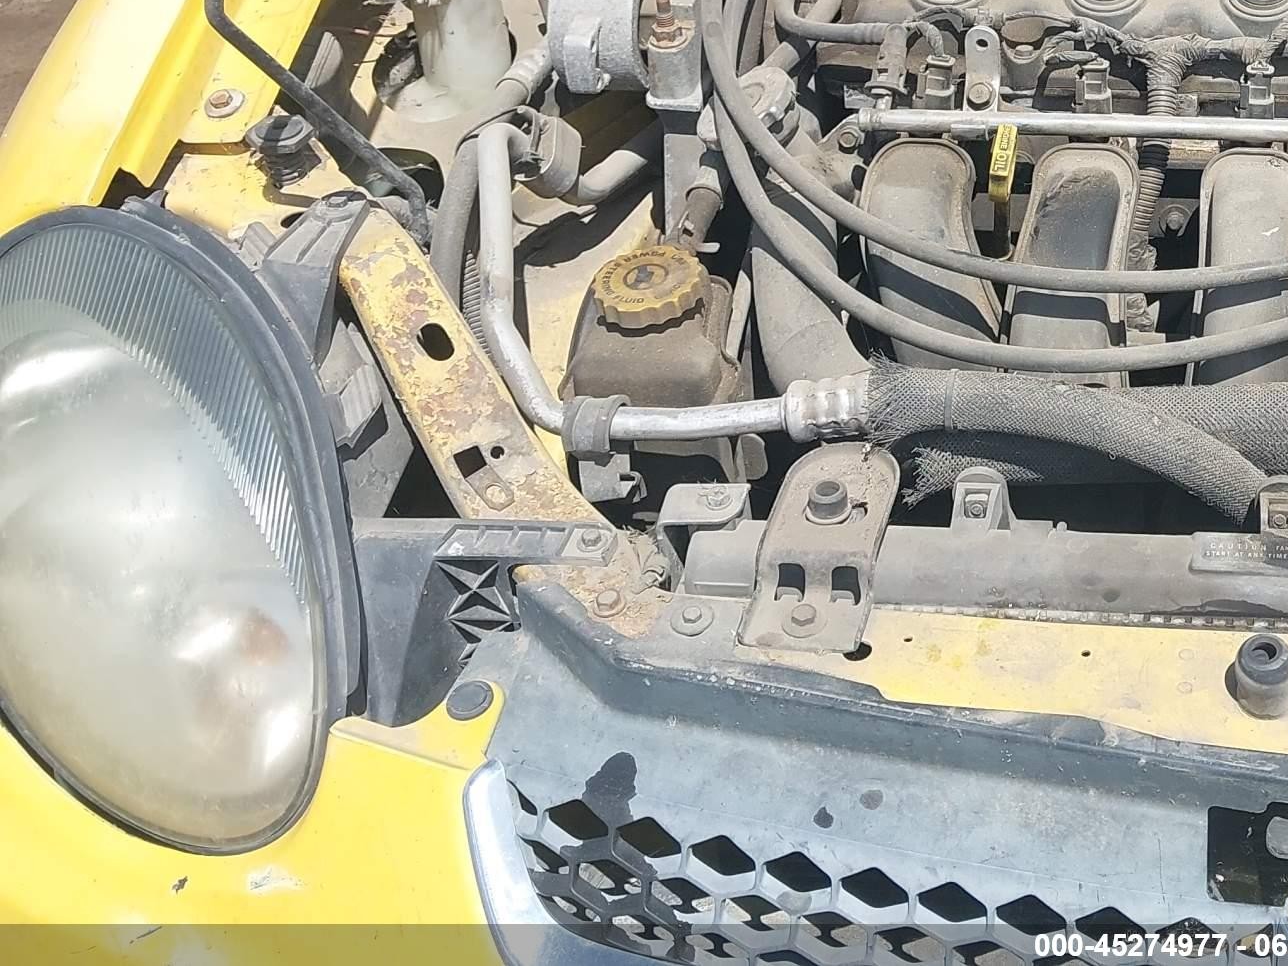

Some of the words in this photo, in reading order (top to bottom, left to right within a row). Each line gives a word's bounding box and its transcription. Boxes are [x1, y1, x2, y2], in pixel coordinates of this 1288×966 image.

[1000, 123, 1012, 150] ENGINE
[994, 154, 1007, 171] OIL
[623, 249, 666, 263] POWER
[1210, 542, 1266, 551] CAUTION
